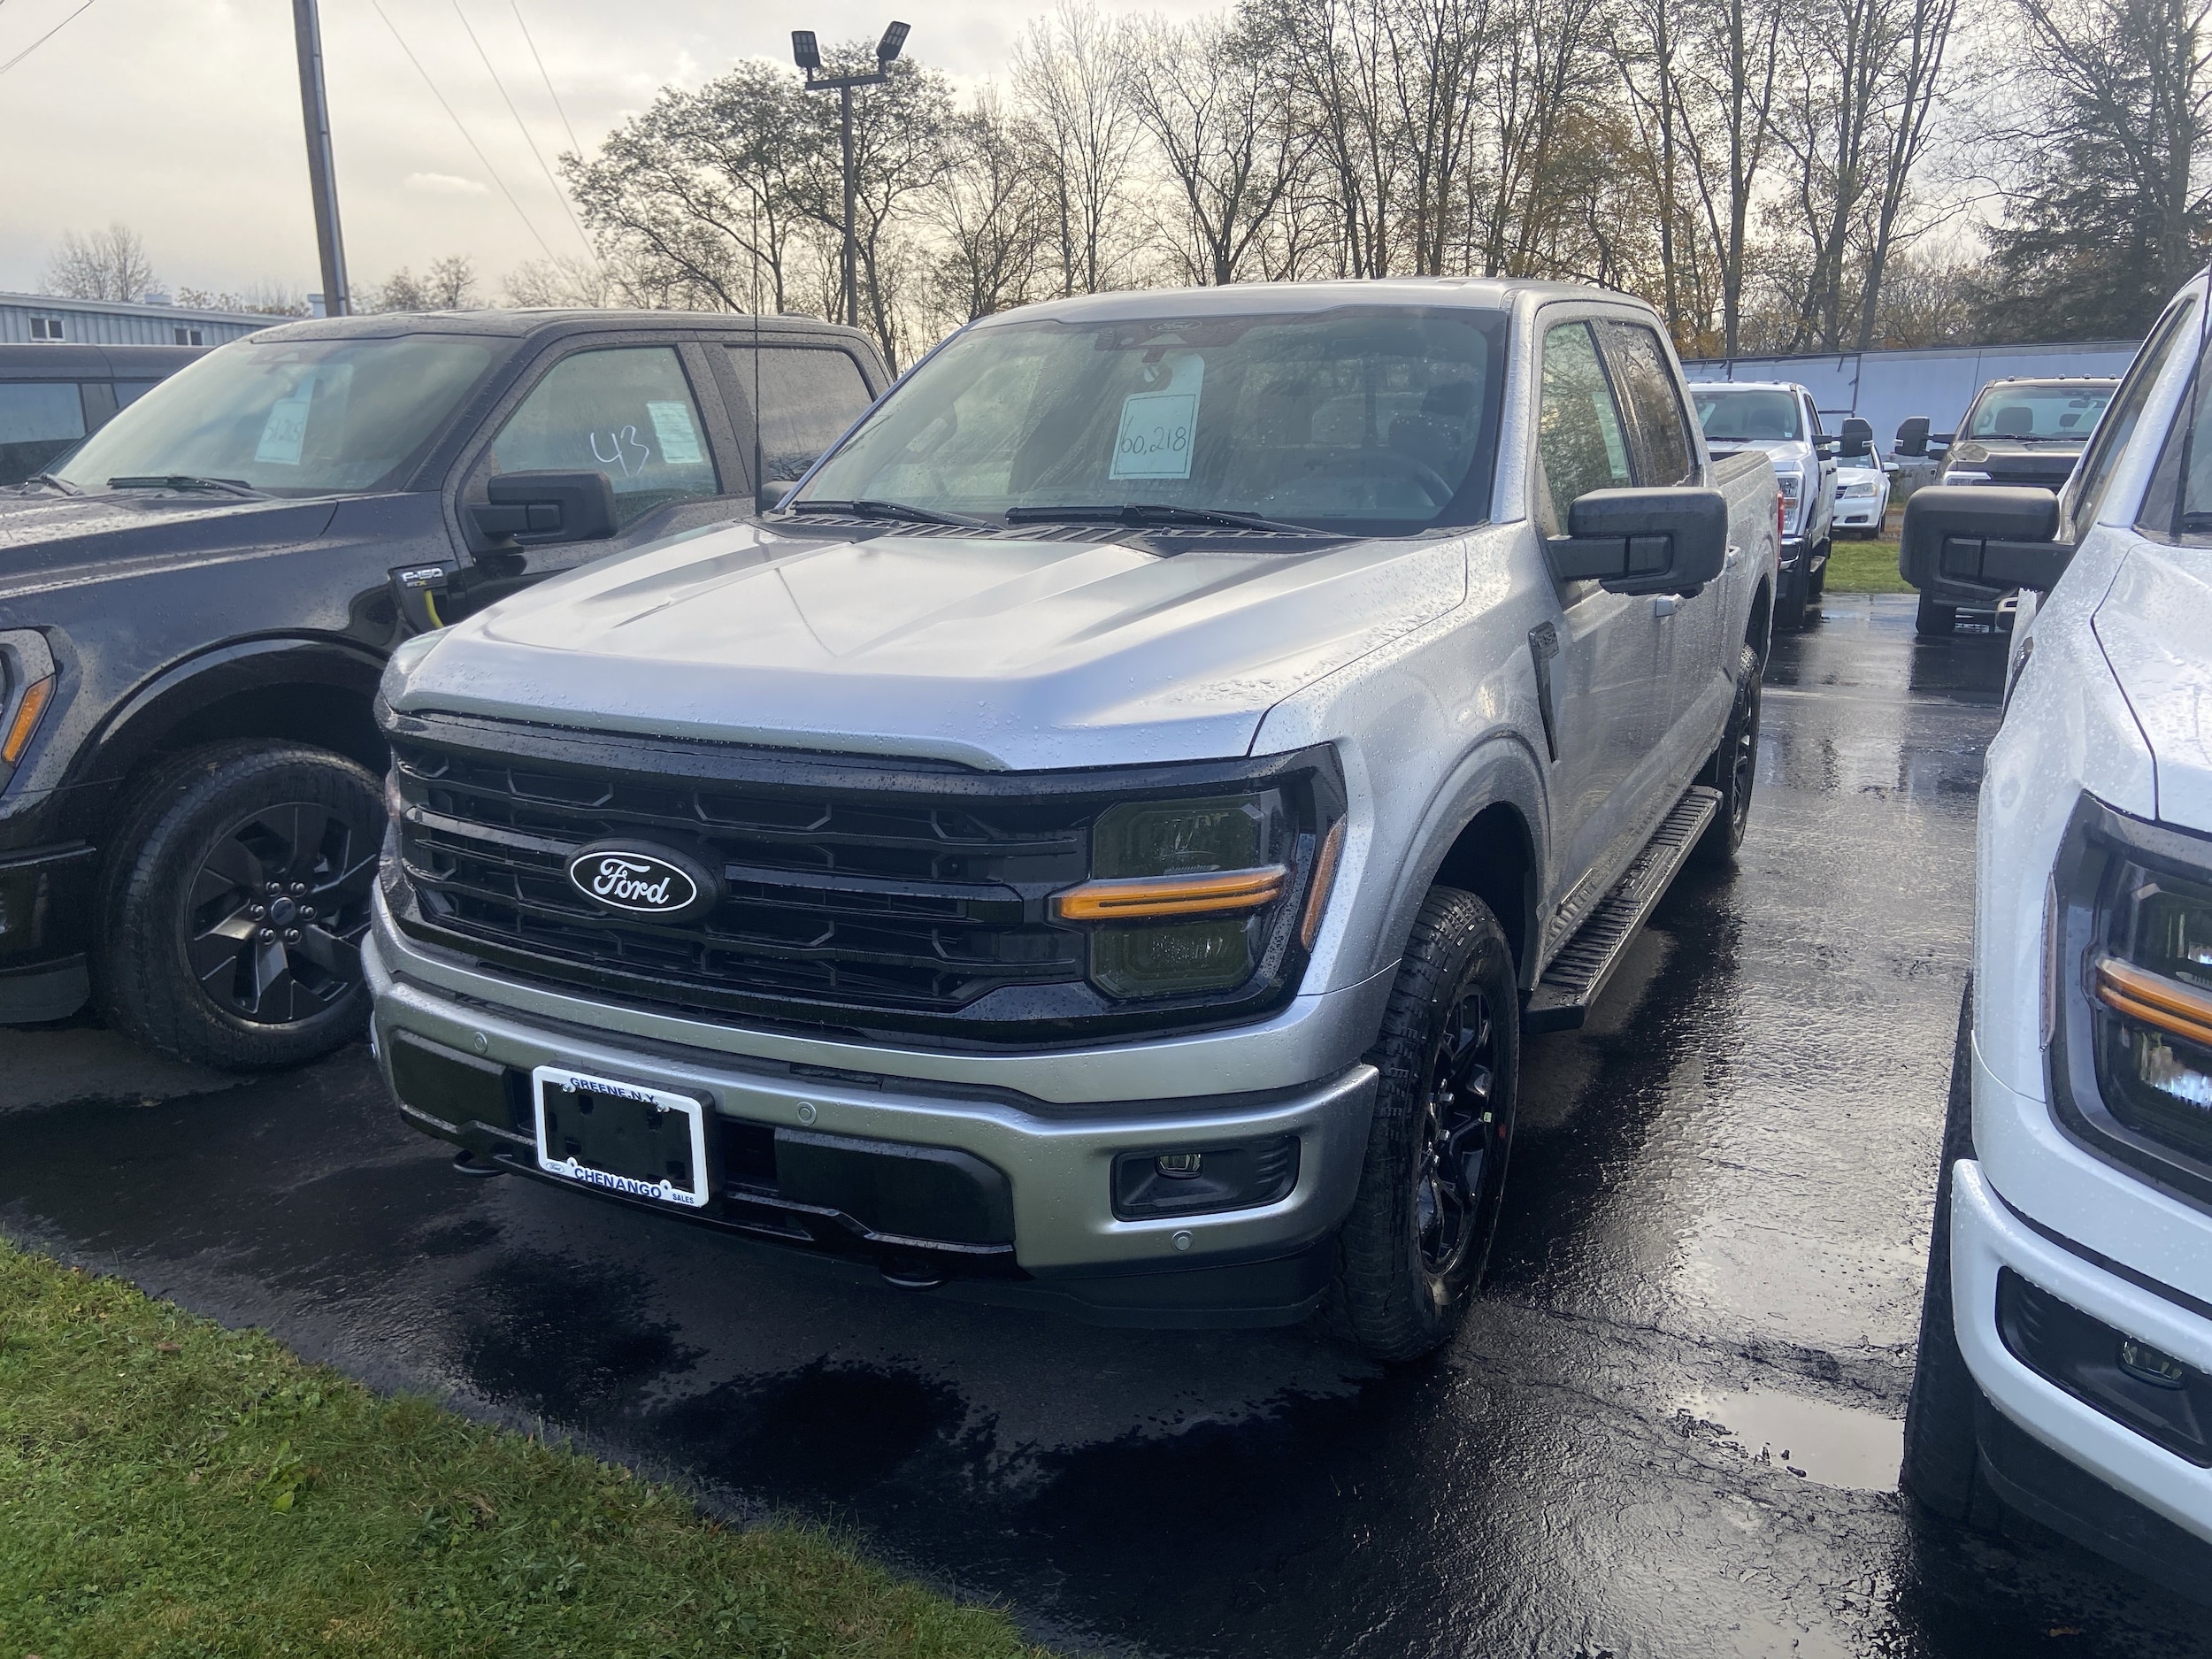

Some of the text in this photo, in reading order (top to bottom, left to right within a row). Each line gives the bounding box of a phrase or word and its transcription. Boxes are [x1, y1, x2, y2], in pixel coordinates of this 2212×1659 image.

[590, 426, 649, 478] 43
[1121, 415, 1187, 455] 60,218
[403, 567, 443, 582] F-150
[594, 858, 671, 904] Ford
[575, 1167, 695, 1204] CHENANGO SALES
